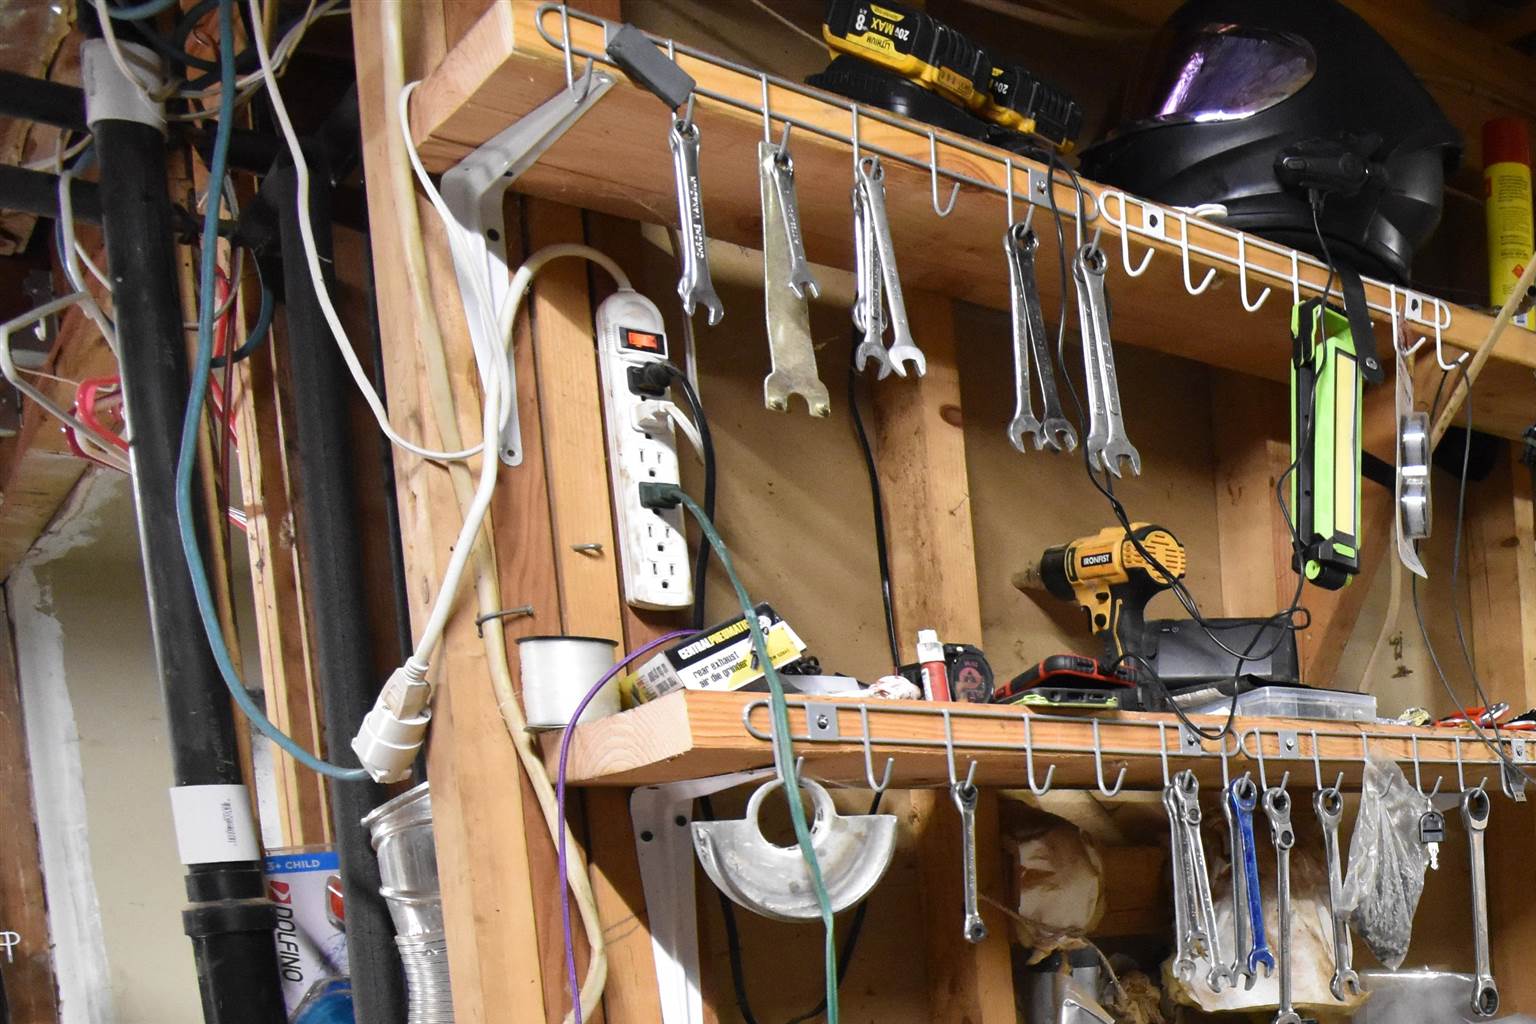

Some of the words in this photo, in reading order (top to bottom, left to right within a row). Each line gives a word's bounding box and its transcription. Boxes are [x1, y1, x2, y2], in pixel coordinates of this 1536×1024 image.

[870, 17, 895, 36] MAX
[866, 36, 891, 50] LITHIUM
[693, 664, 710, 679] rear
[712, 651, 739, 670] exhaust
[699, 674, 709, 688] air
[711, 669, 721, 681] die
[722, 658, 747, 678] grinder
[285, 859, 320, 870] CHILD
[276, 906, 304, 983] DOLFINO
